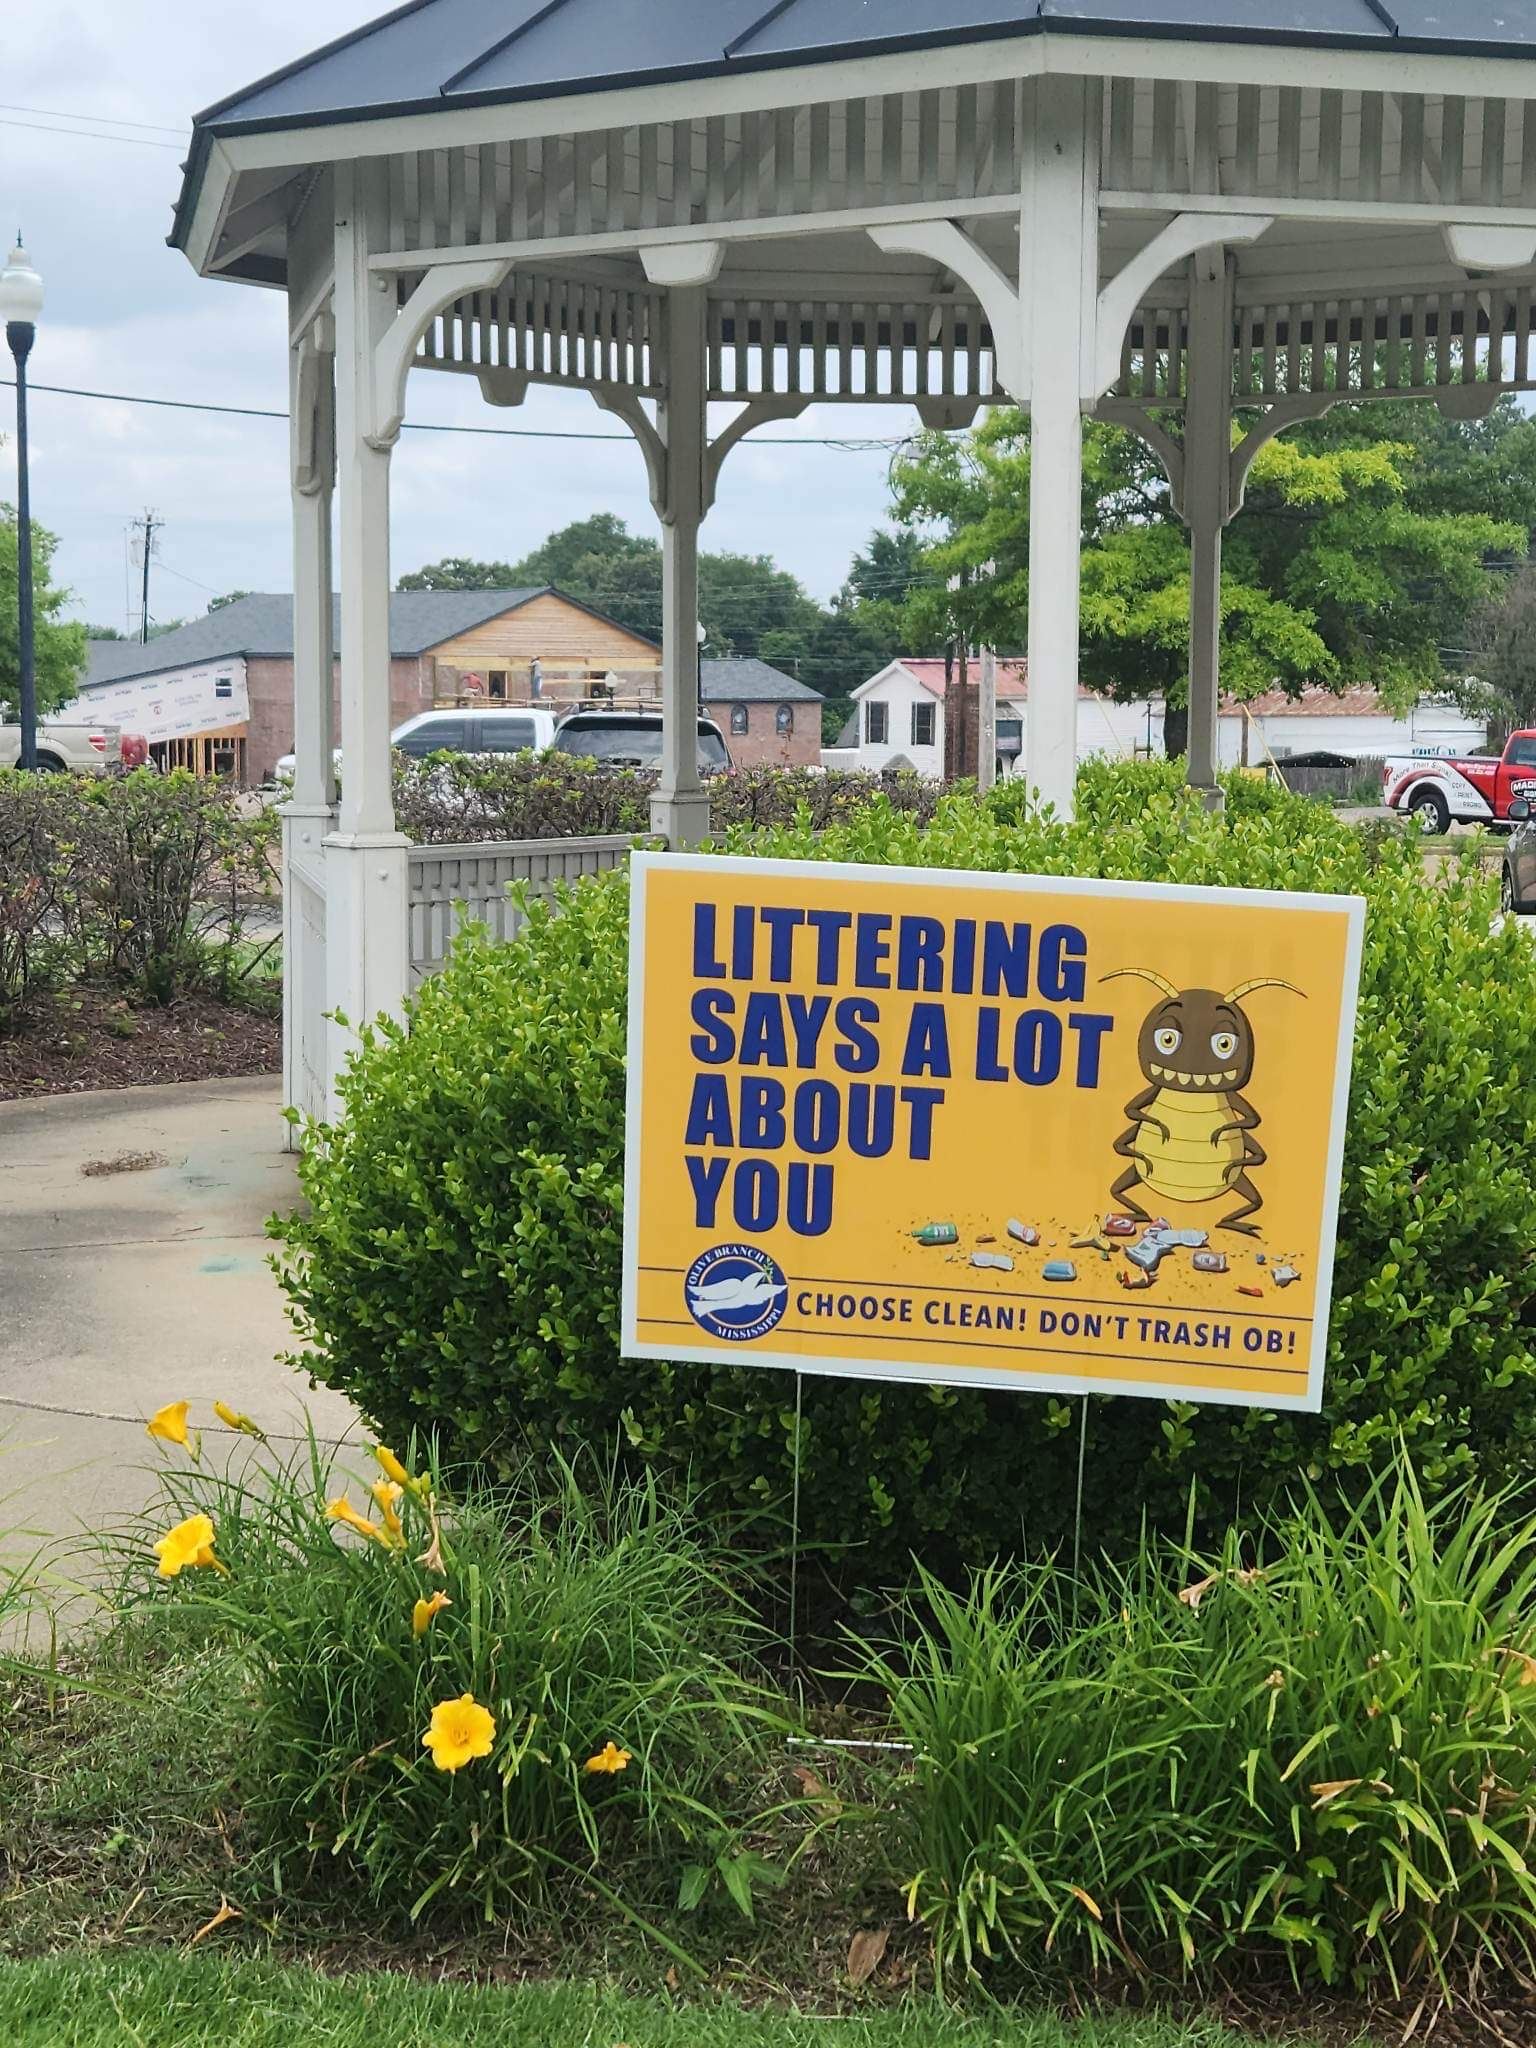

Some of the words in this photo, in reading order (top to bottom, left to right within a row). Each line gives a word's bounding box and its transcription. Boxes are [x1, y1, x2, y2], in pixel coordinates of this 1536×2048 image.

[693, 902, 1088, 1003] LITTERING
[690, 988, 880, 1074] SAYS
[901, 1002, 952, 1079] A
[975, 1006, 1114, 1089] LOT
[684, 1072, 945, 1161] ABOUT
[684, 1155, 835, 1237] YOU
[688, 1252, 714, 1285] OLIVE
[714, 1246, 765, 1263] BRANCH
[716, 1308, 783, 1339] MISSISSIPPI
[796, 1292, 913, 1322] CHOOSE
[924, 1300, 1026, 1331] CLEAN!
[1039, 1310, 1130, 1340] DON'T
[1137, 1317, 1231, 1349] TRASH
[1243, 1327, 1296, 1355] OB!
